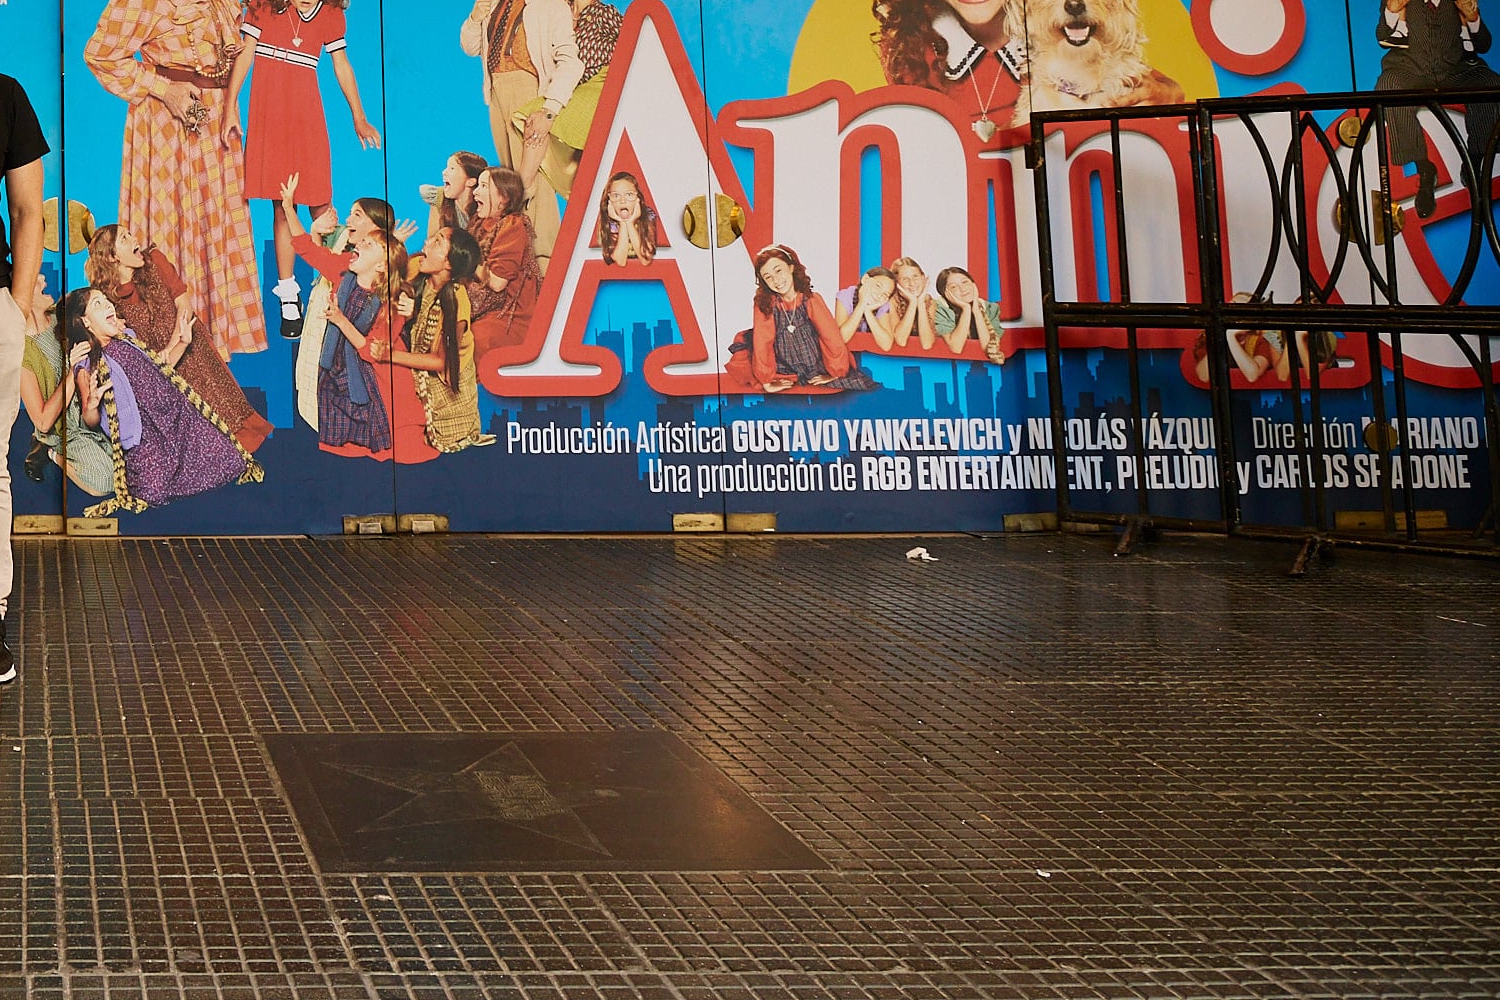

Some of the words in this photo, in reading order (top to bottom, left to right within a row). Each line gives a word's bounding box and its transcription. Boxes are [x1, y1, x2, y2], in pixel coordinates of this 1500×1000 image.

[506, 420, 631, 455] Producción
[636, 419, 727, 454] Artística
[732, 419, 840, 453] GUSTAVO
[843, 418, 1003, 452] YANKELEVICH
[648, 457, 692, 494] Una
[697, 456, 823, 499] producción
[829, 457, 857, 492] de
[861, 456, 911, 492] RGB
